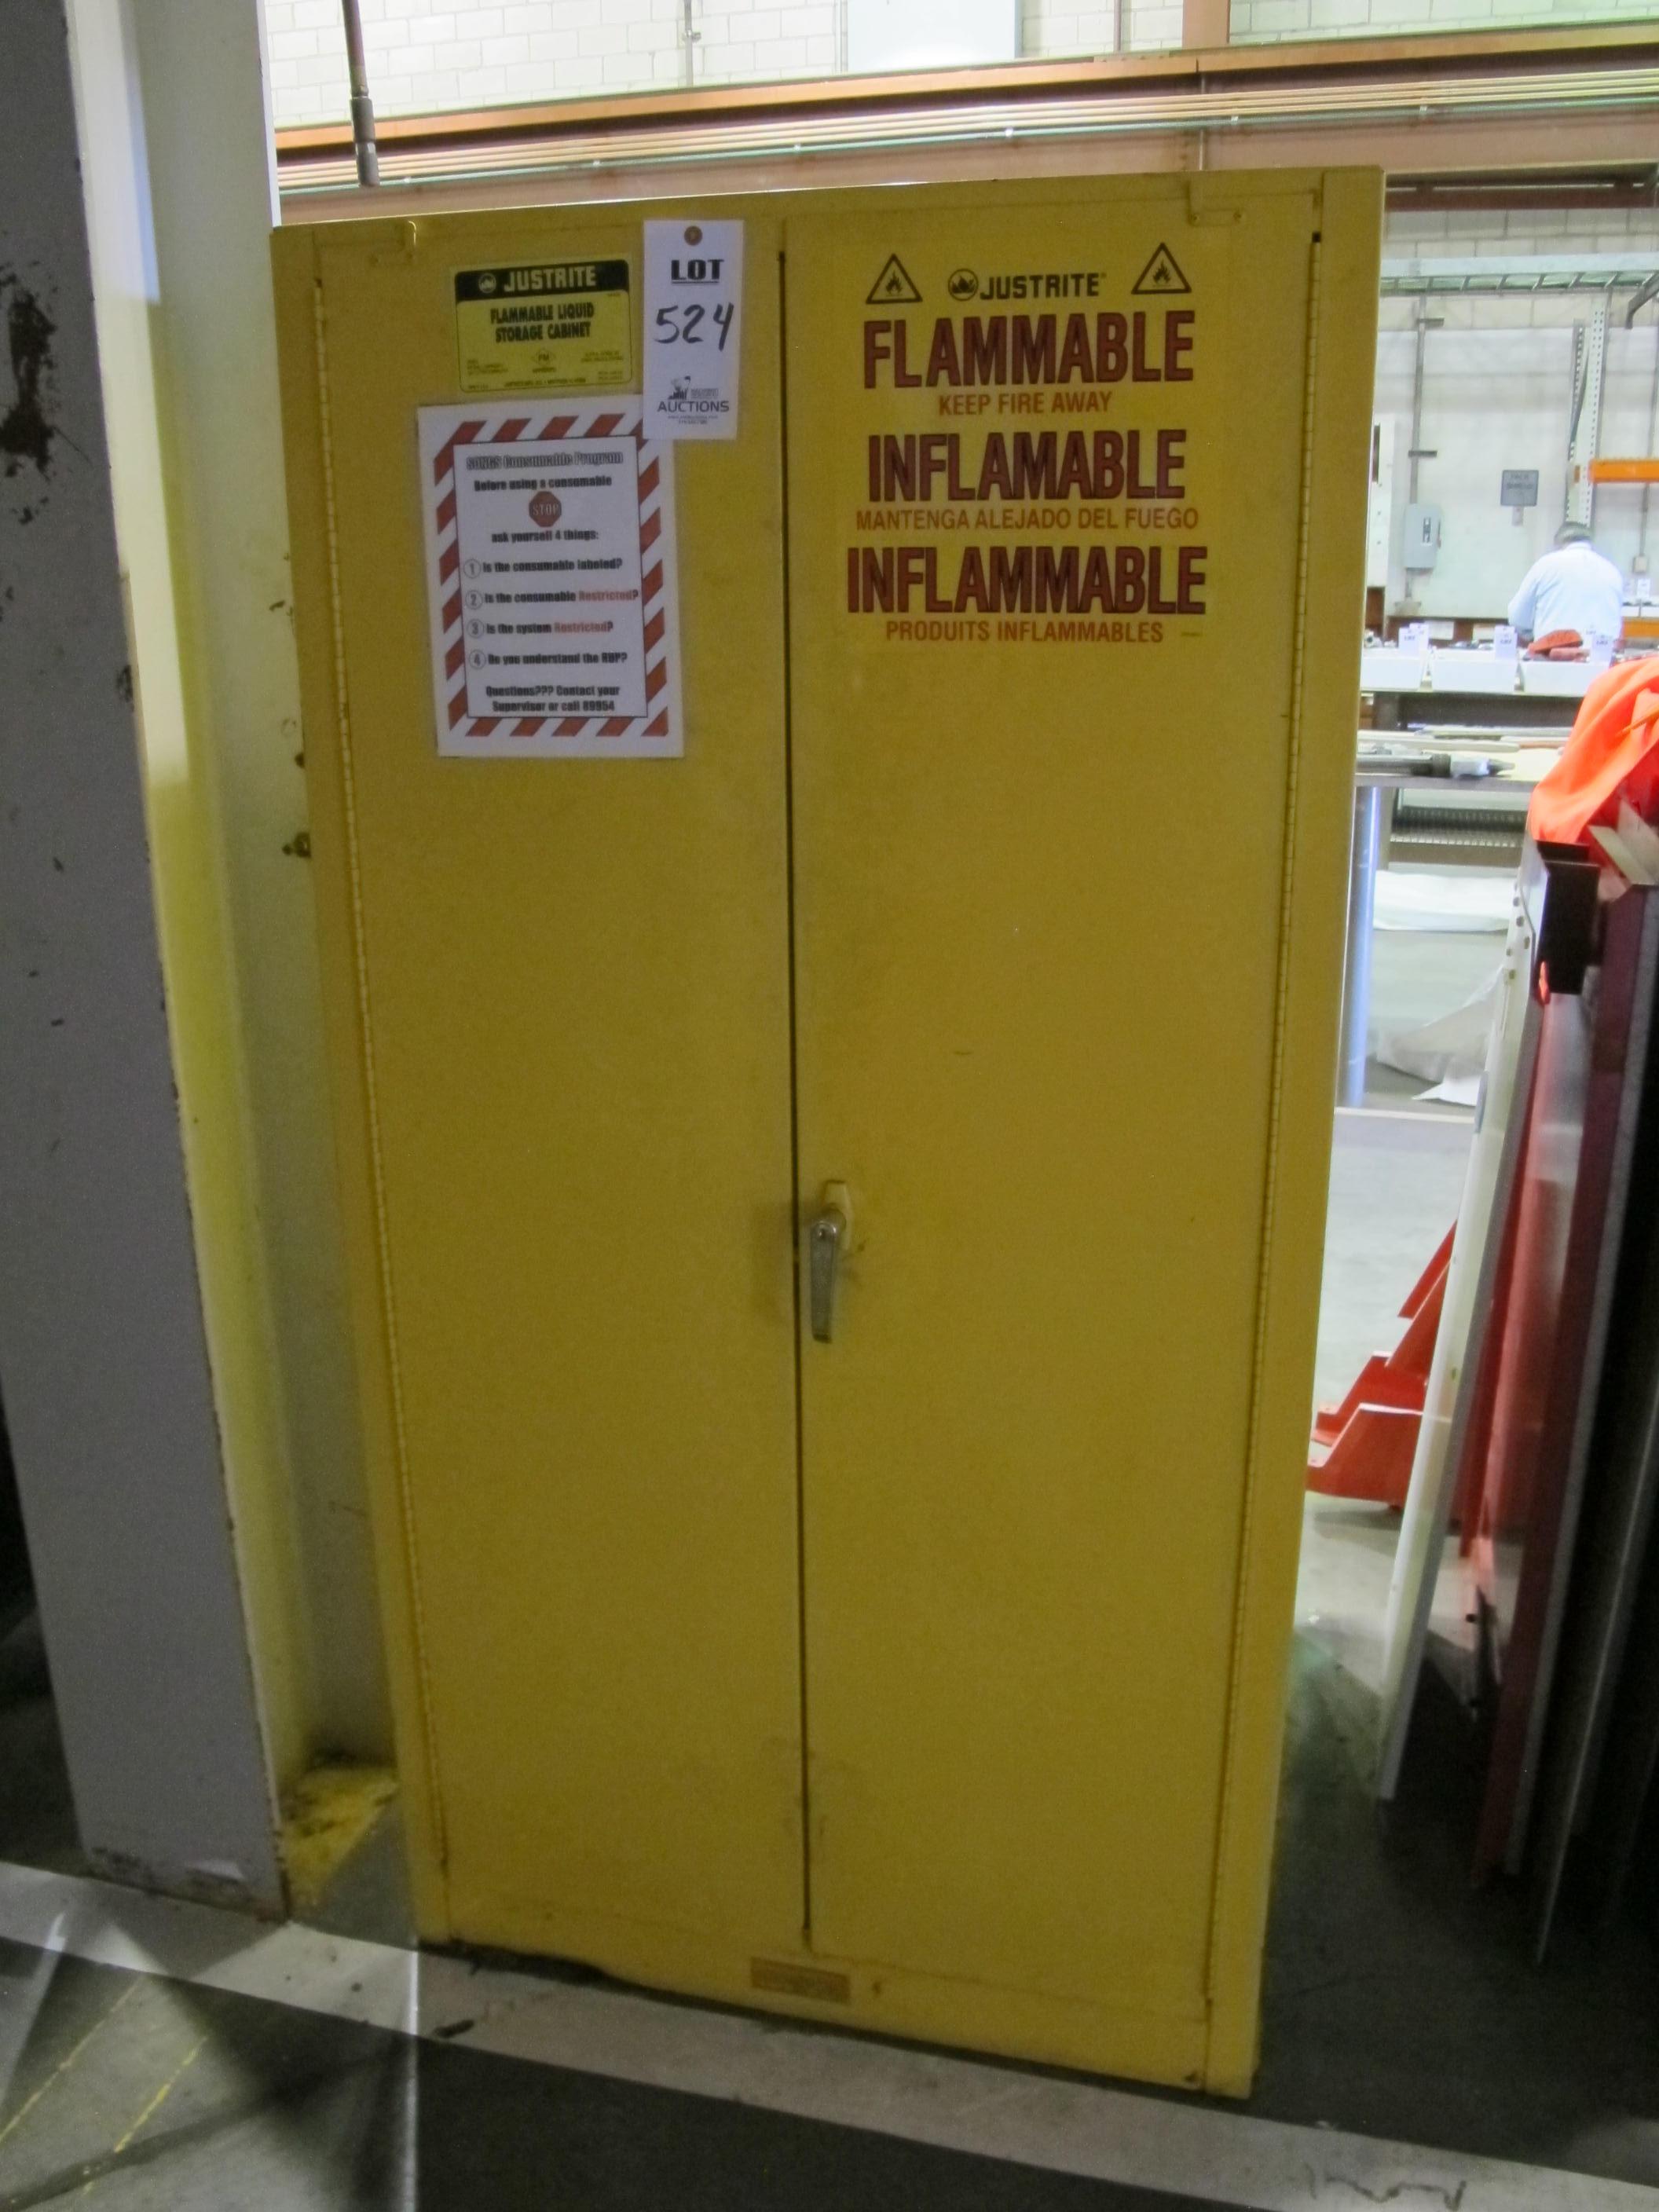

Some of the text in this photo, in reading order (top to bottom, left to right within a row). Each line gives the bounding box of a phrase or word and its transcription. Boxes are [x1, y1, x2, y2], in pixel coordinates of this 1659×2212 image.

[504, 266, 596, 291] JUSTRITE
[671, 259, 724, 281] LOT
[980, 273, 1099, 300] JUSTRITE
[490, 302, 595, 324] FLAMMABLE LIQUID
[496, 321, 591, 343] STORAGE CABINET
[654, 302, 734, 352] 524
[864, 310, 1196, 389] FLAMMABLE
[657, 400, 730, 412] AUCTIONS
[939, 390, 1113, 416] KEEP FIRE AWAY
[869, 429, 1187, 503] INFLAMABLE
[474, 480, 507, 492] Before
[509, 478, 537, 489] using
[548, 475, 612, 488] consumable
[533, 504, 559, 516] STOP
[855, 507, 1199, 531] MANTENGA ALEJADO DEL FUEGO
[492, 529, 599, 543] ask yourself 4 things:
[483, 562, 492, 573] Is
[494, 562, 511, 573] the
[513, 559, 575, 572] consumable
[577, 557, 623, 570] labeled?
[848, 545, 1207, 614] INFLAMMABLE
[485, 593, 494, 603] Is
[496, 592, 512, 603] the
[515, 591, 576, 602] consumable
[486, 624, 496, 634] Is
[498, 623, 513, 634] the
[516, 623, 551, 635] system
[885, 621, 1164, 643] PRODUITS INFLAMMABLES
[503, 655, 520, 665] you
[522, 654, 580, 665] understand
[583, 654, 599, 664] the
[485, 685, 620, 698] Questions??? Contact your
[493, 701, 545, 712] Supervisor
[548, 702, 558, 712] or
[562, 701, 580, 711] call
